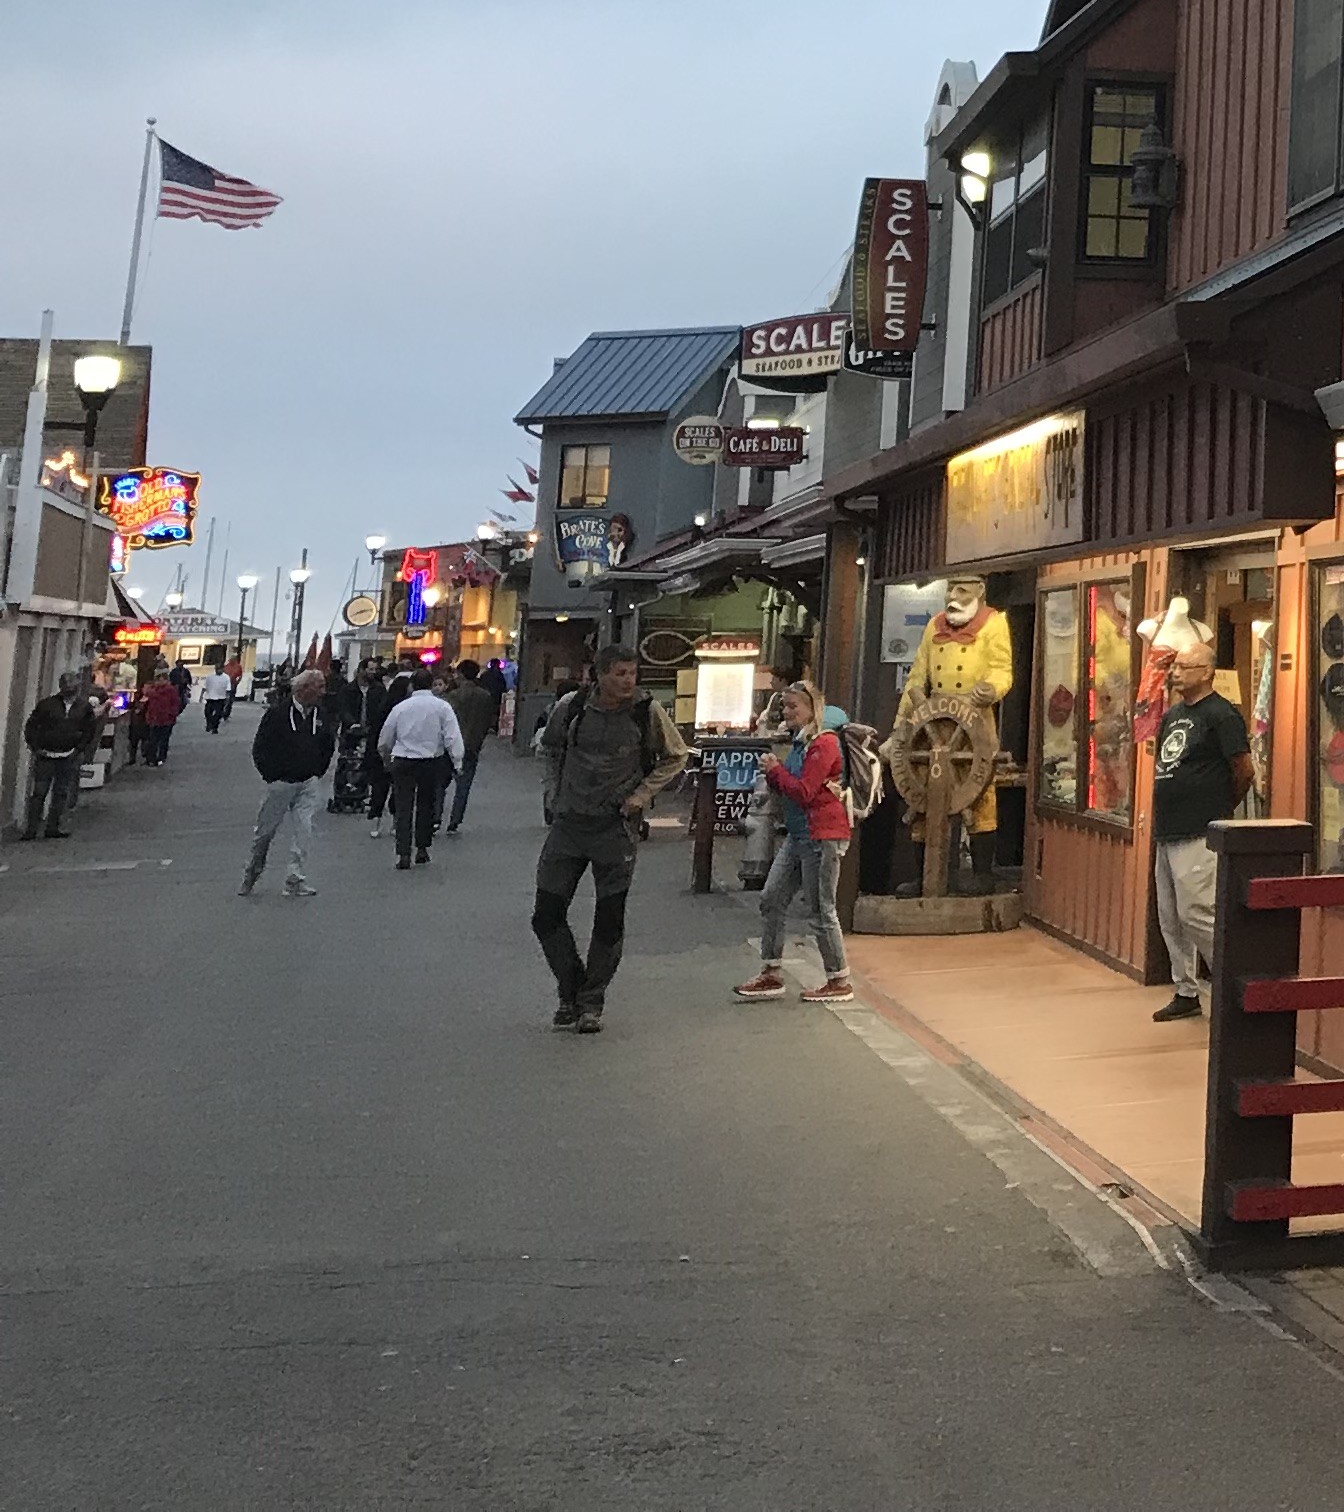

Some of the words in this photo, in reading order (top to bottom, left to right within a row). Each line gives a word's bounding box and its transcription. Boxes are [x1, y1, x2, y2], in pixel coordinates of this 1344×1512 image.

[884, 188, 913, 340] SCALES
[751, 319, 853, 355] SCALE
[755, 356, 803, 373] SEAFOOD
[685, 427, 715, 437] SCALES
[771, 436, 798, 452] DELI
[702, 642, 754, 651] SCALES
[907, 697, 978, 728] WELCOME
[930, 746, 943, 779] TO
